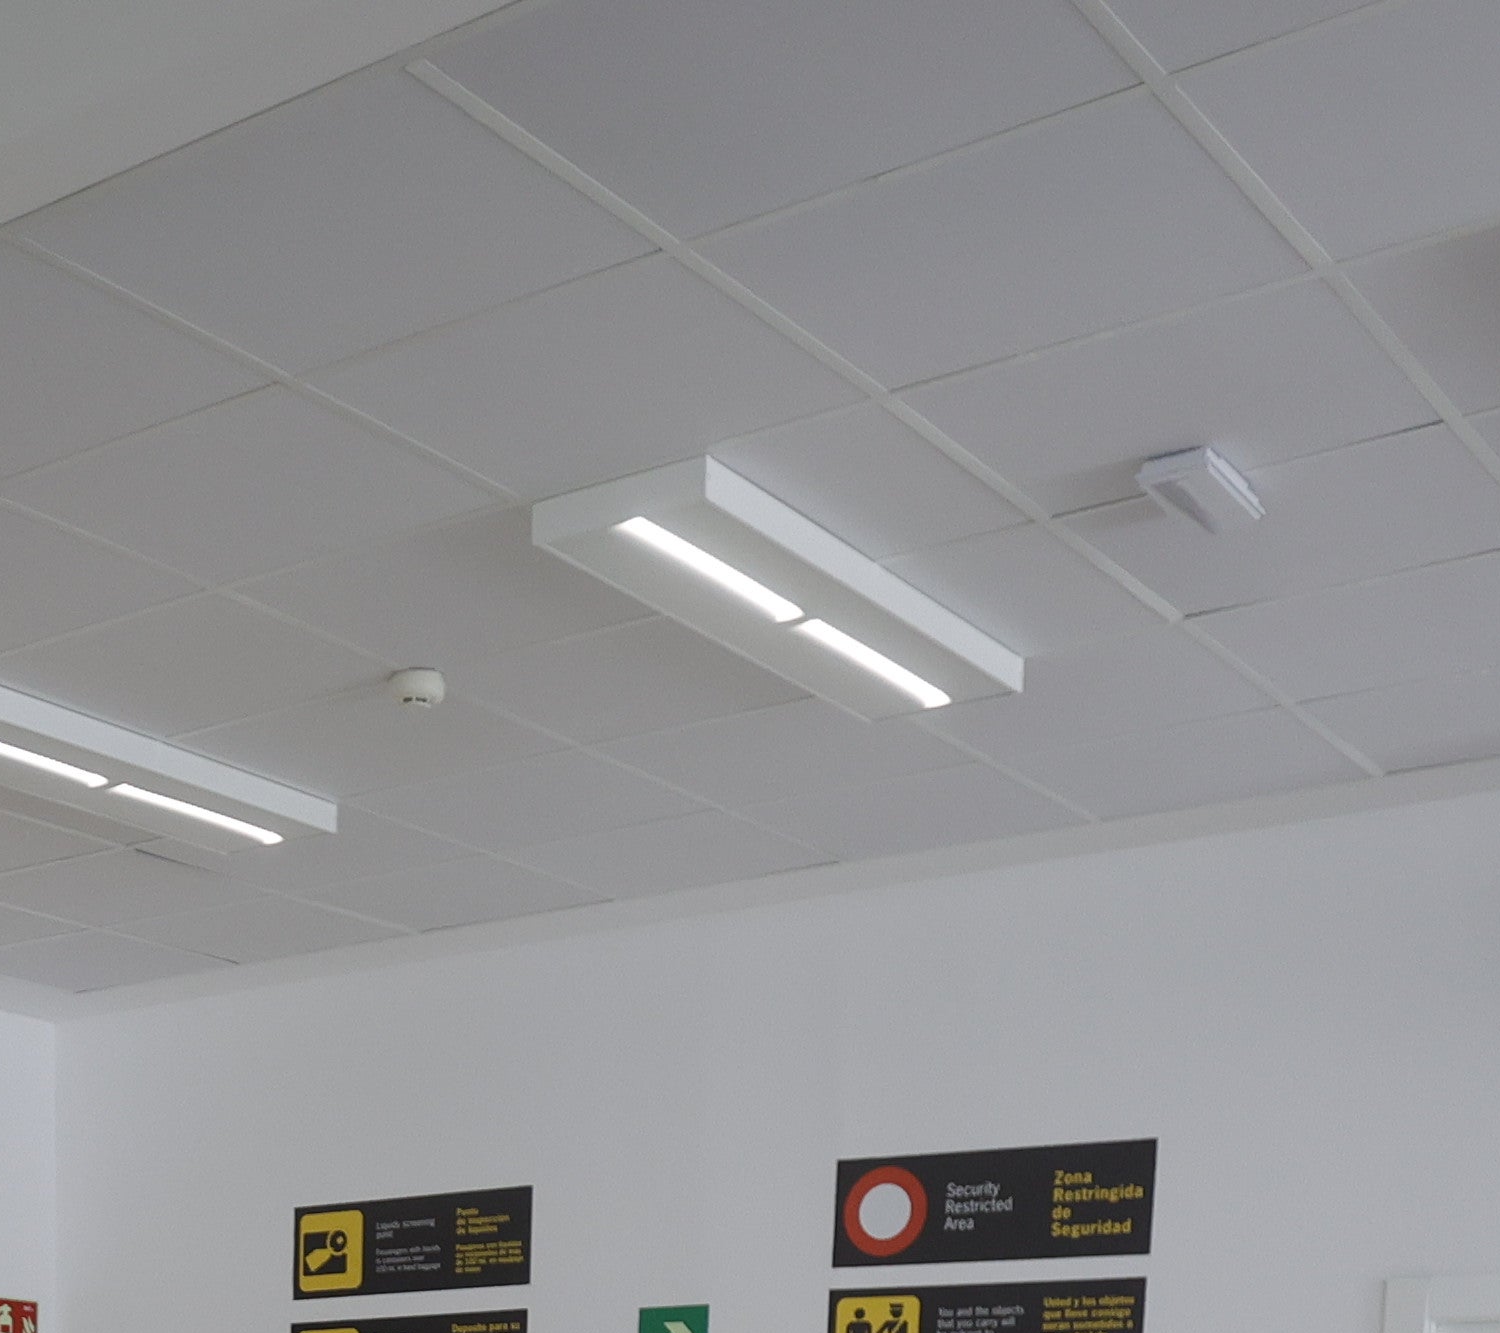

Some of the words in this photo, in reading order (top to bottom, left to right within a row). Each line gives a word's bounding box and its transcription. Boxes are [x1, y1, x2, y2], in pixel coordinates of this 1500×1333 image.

[1054, 1169, 1093, 1185] Zona
[946, 1180, 1001, 1198] Security
[1052, 1183, 1145, 1203] Restringida
[944, 1196, 1014, 1215] Restricted
[1052, 1205, 1071, 1220] de
[944, 1216, 975, 1231] Area
[1051, 1218, 1133, 1239] Seguridad
